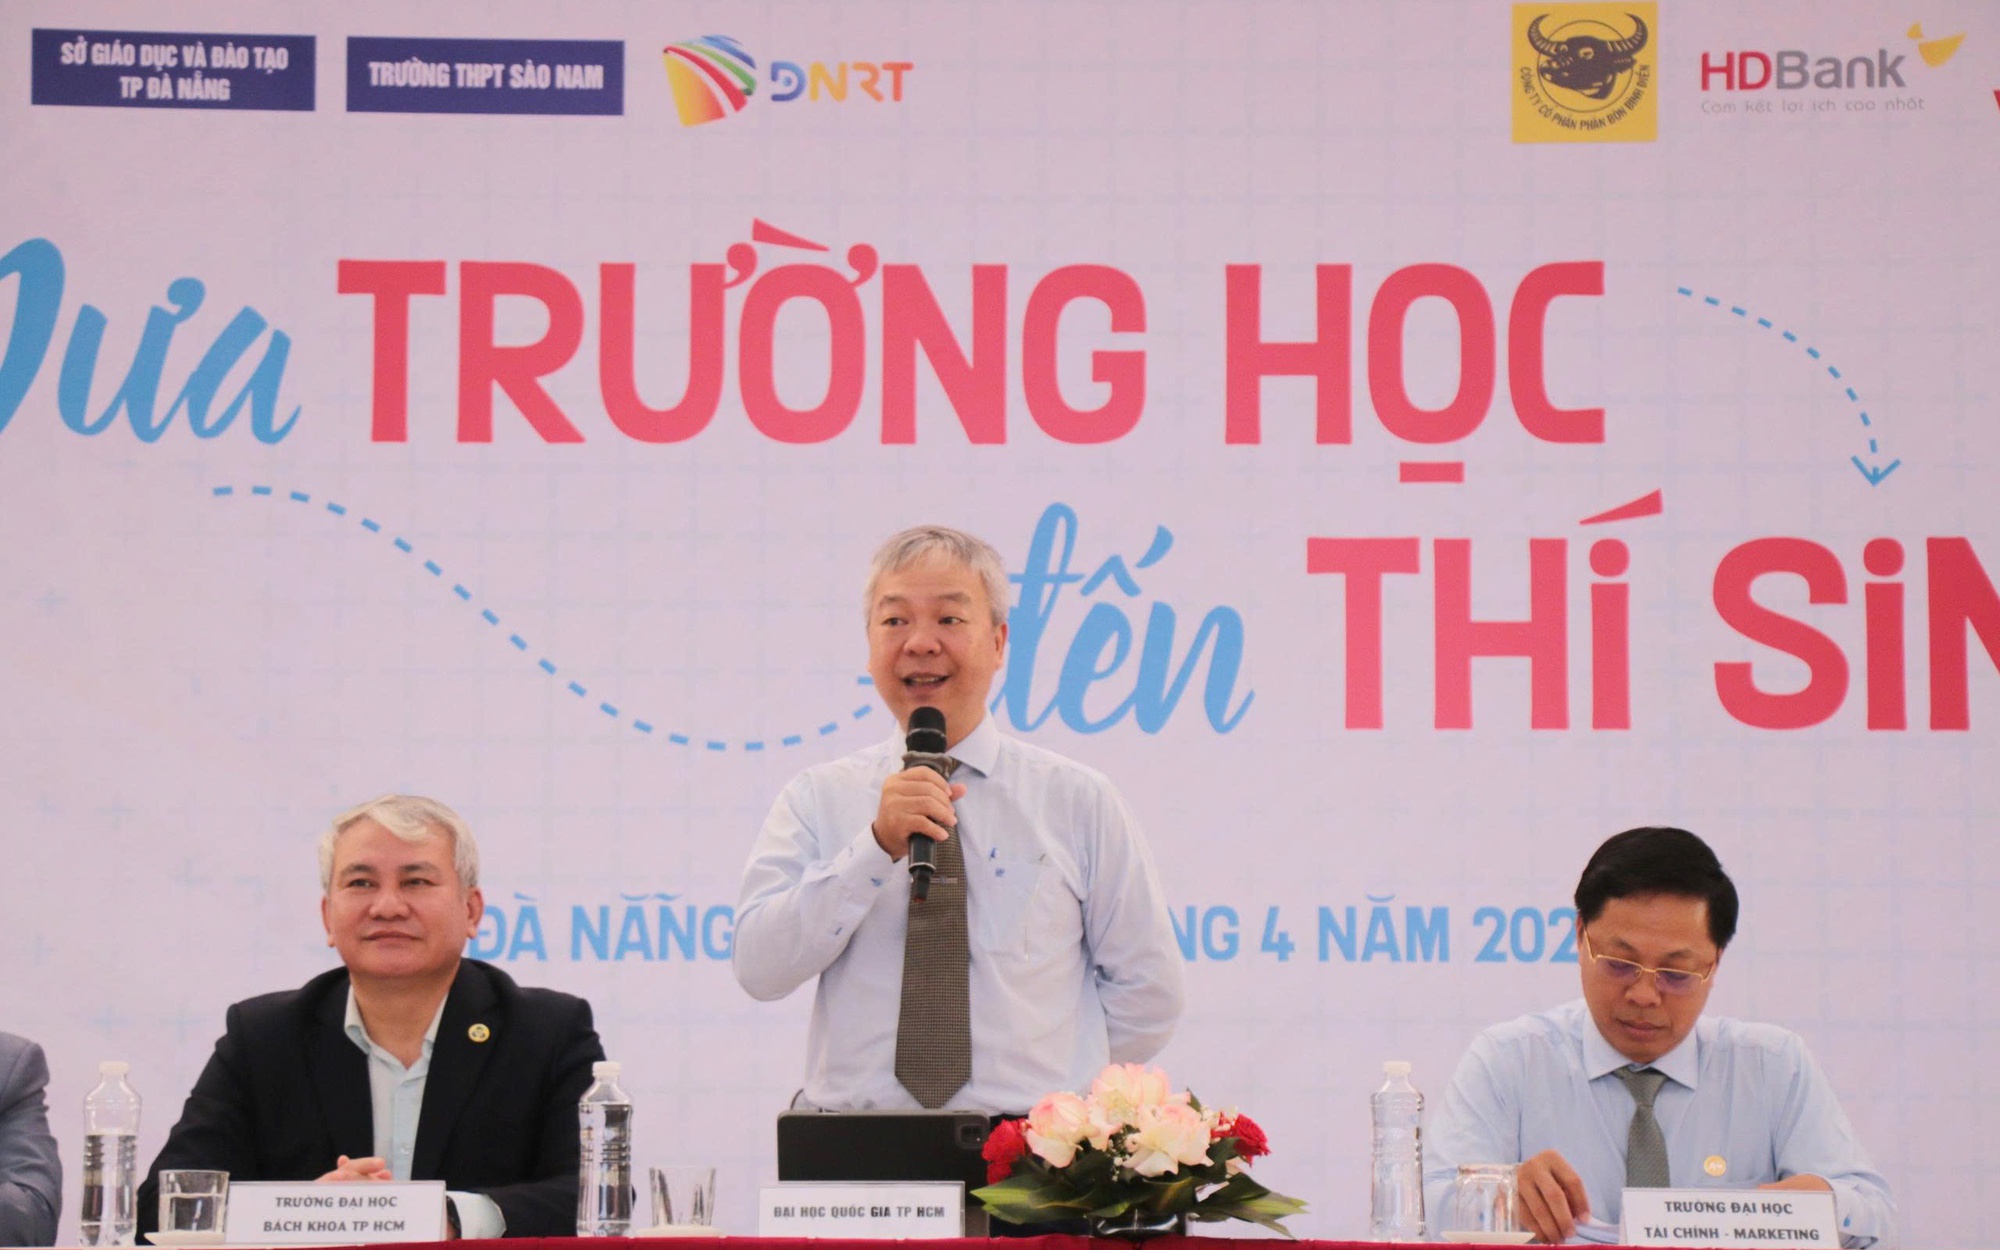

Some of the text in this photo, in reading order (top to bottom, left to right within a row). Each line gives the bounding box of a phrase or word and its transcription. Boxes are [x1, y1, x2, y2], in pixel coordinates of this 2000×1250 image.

[61, 35, 289, 74] SỞ GIÁO DỤC VÀ ĐÀO TẠO
[119, 70, 231, 100] TP ĐÀ NẴNG
[368, 56, 604, 89] TRƯỜNG THPT SÀO NAM
[770, 61, 914, 102] DNRT
[1700, 49, 1906, 91] HDBank
[1701, 99, 1736, 114] Cam
[337, 218, 1147, 445] TRƯỜNG
[1225, 261, 1606, 483] HỌC
[570, 892, 735, 961] NẴNG
[1261, 906, 1296, 962] 4
[1318, 894, 1450, 962] NĂM
[1473, 906, 1579, 963] 202
[274, 1195, 398, 1210] TRƯỜNG ĐẠI HỌC
[870, 1206, 891, 1218] GIA
[897, 1206, 912, 1218] TP
[917, 1206, 945, 1218] HCM
[1664, 1199, 1793, 1217] TRƯỜNG ĐẠI HỌC
[307, 1220, 347, 1232] KHOA
[352, 1220, 369, 1232] TP
[373, 1219, 405, 1231] HCM
[1644, 1224, 1668, 1239] TÀI
[1733, 1228, 1820, 1241] MARKETING
